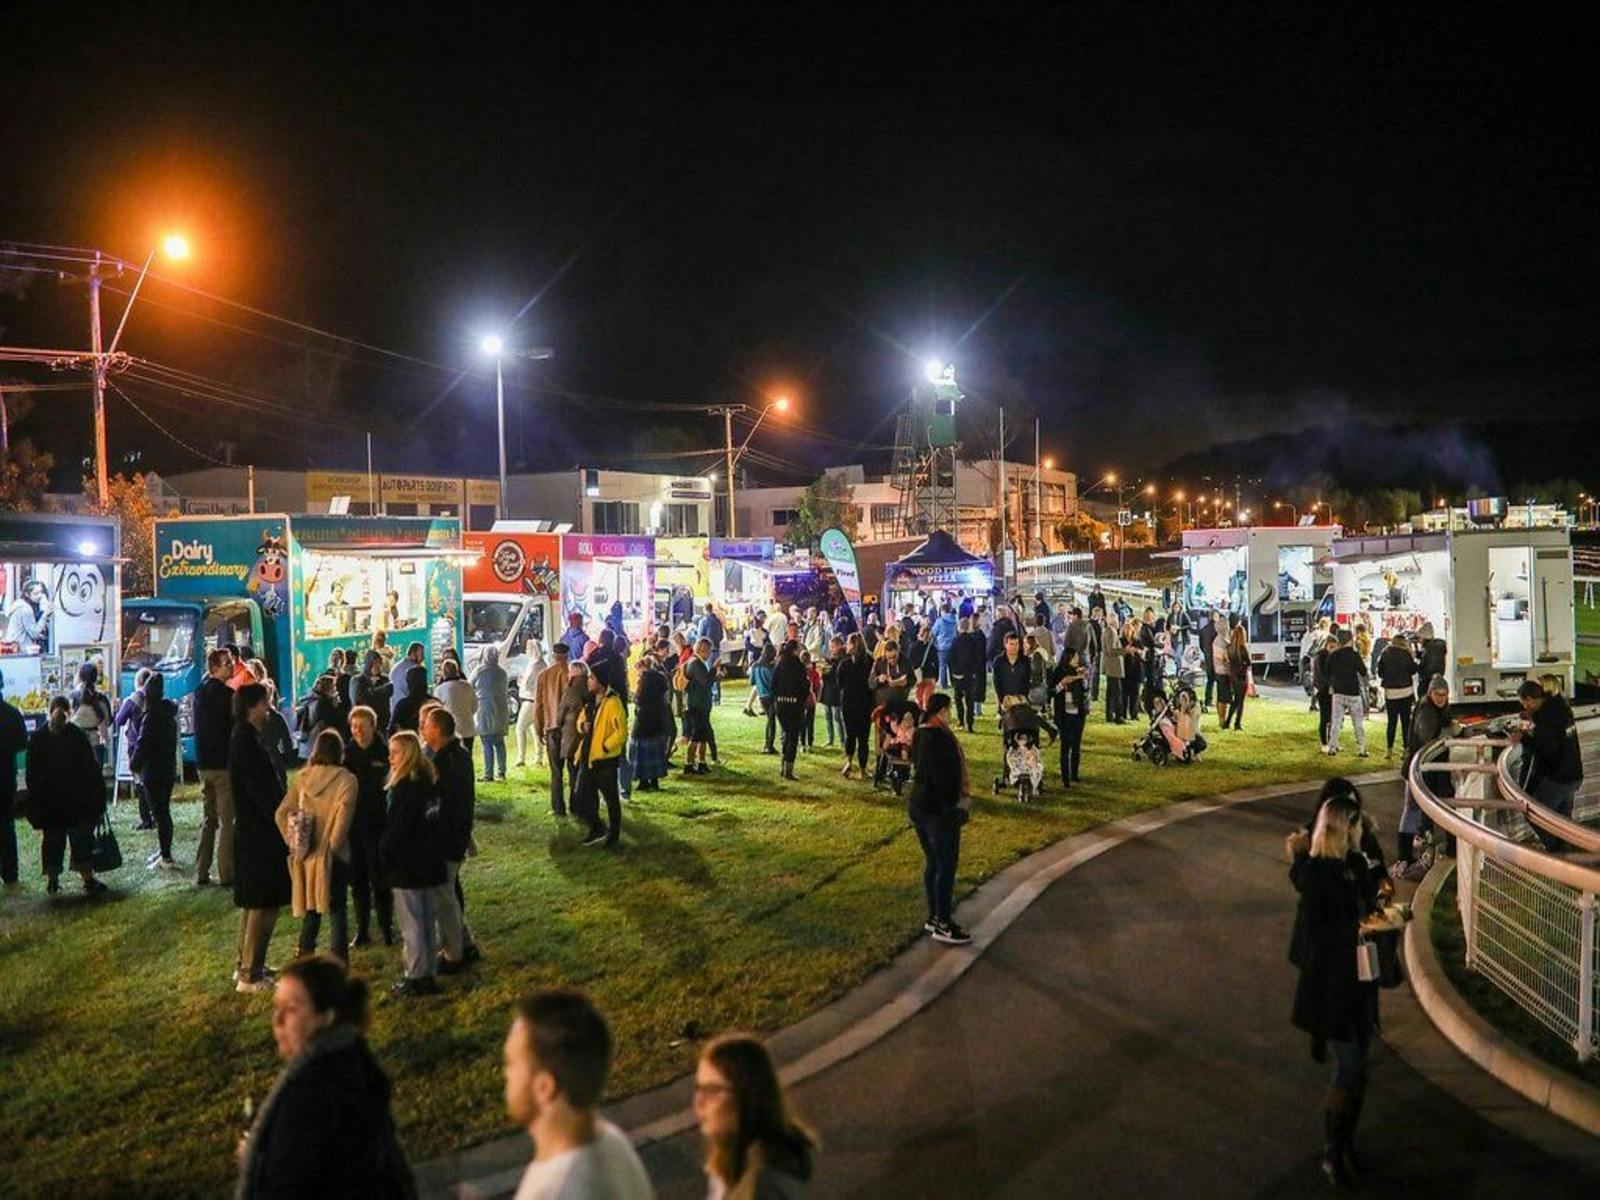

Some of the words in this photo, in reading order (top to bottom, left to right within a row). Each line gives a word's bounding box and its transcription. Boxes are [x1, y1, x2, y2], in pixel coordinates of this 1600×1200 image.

[171, 539, 213, 565] Dairy
[159, 555, 249, 580] Extraordinary
[910, 566, 941, 576] WOOD
